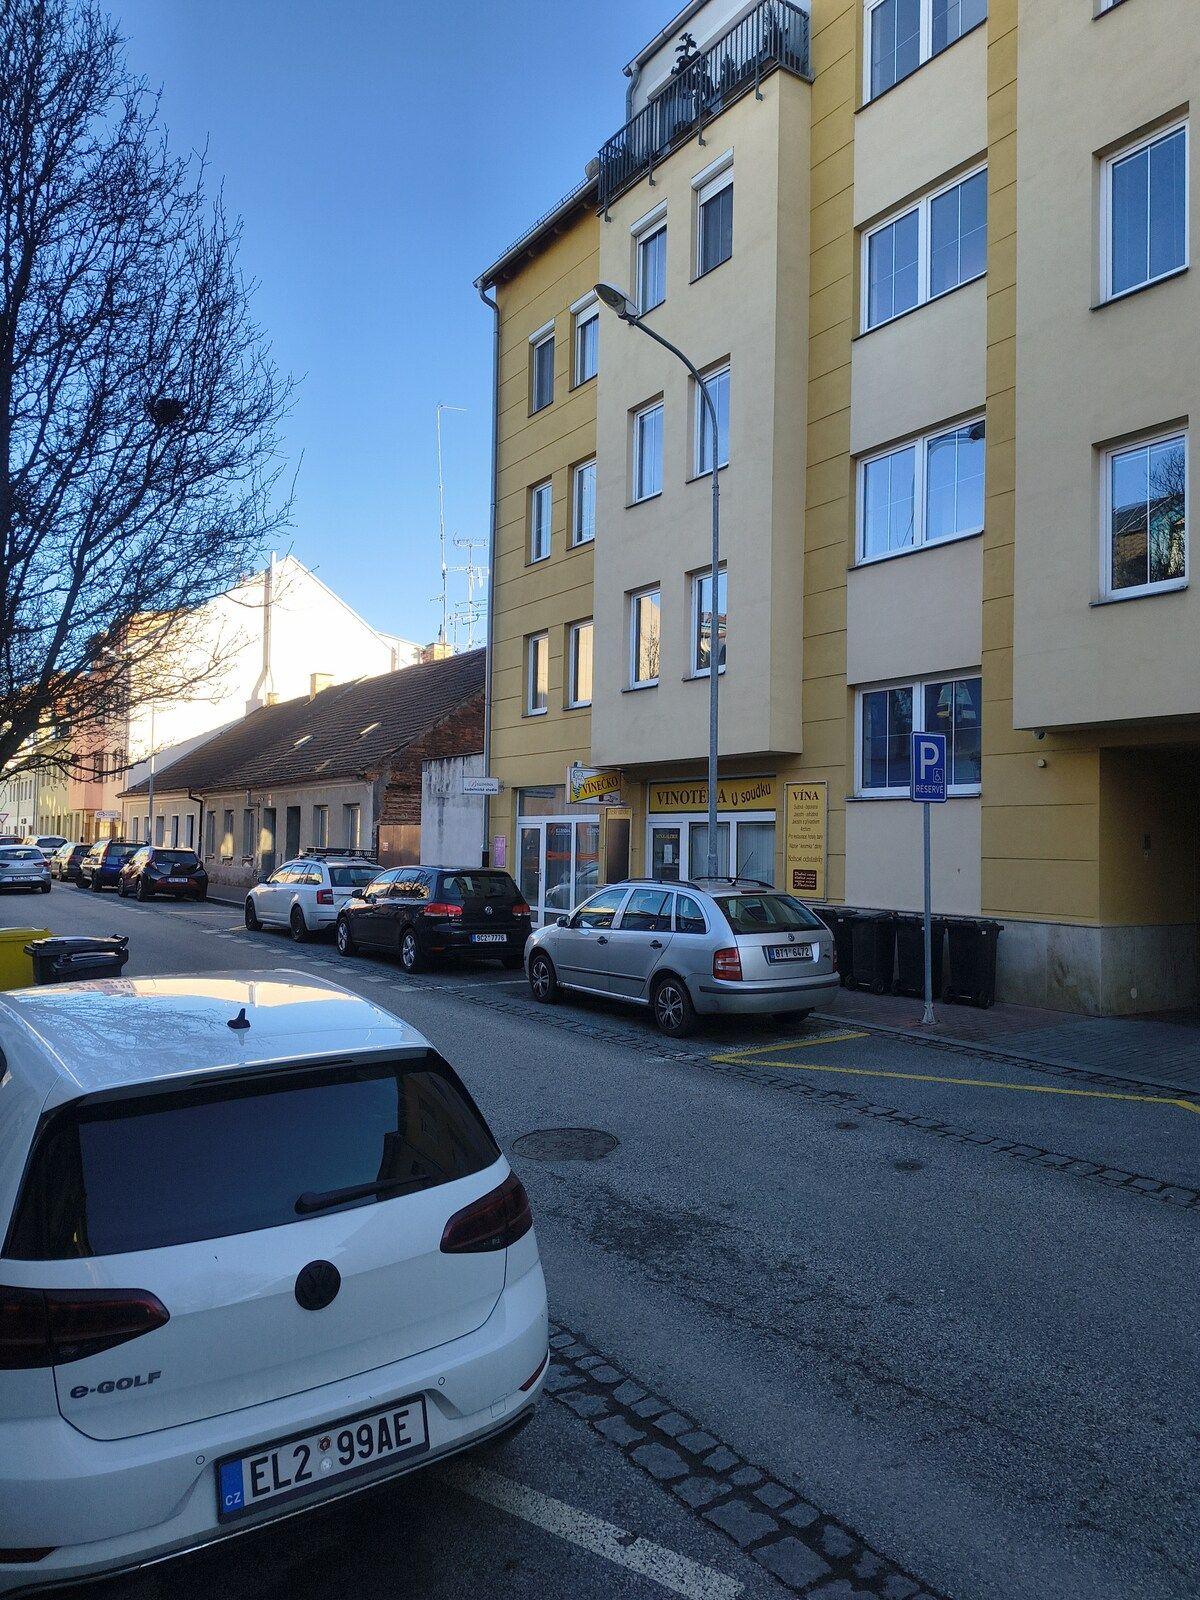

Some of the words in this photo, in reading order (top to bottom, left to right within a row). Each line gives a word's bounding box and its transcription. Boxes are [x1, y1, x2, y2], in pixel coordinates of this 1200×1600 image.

[921, 742, 939, 779] P
[582, 777, 618, 795] VÍNEČKO
[657, 785, 727, 805] VINOTÉA
[741, 781, 771, 803] soudku
[792, 789, 819, 800] VÍNA
[251, 1444, 312, 1498] EL2
[337, 1410, 412, 1466] 99AE
[225, 1491, 241, 1506] CZ
